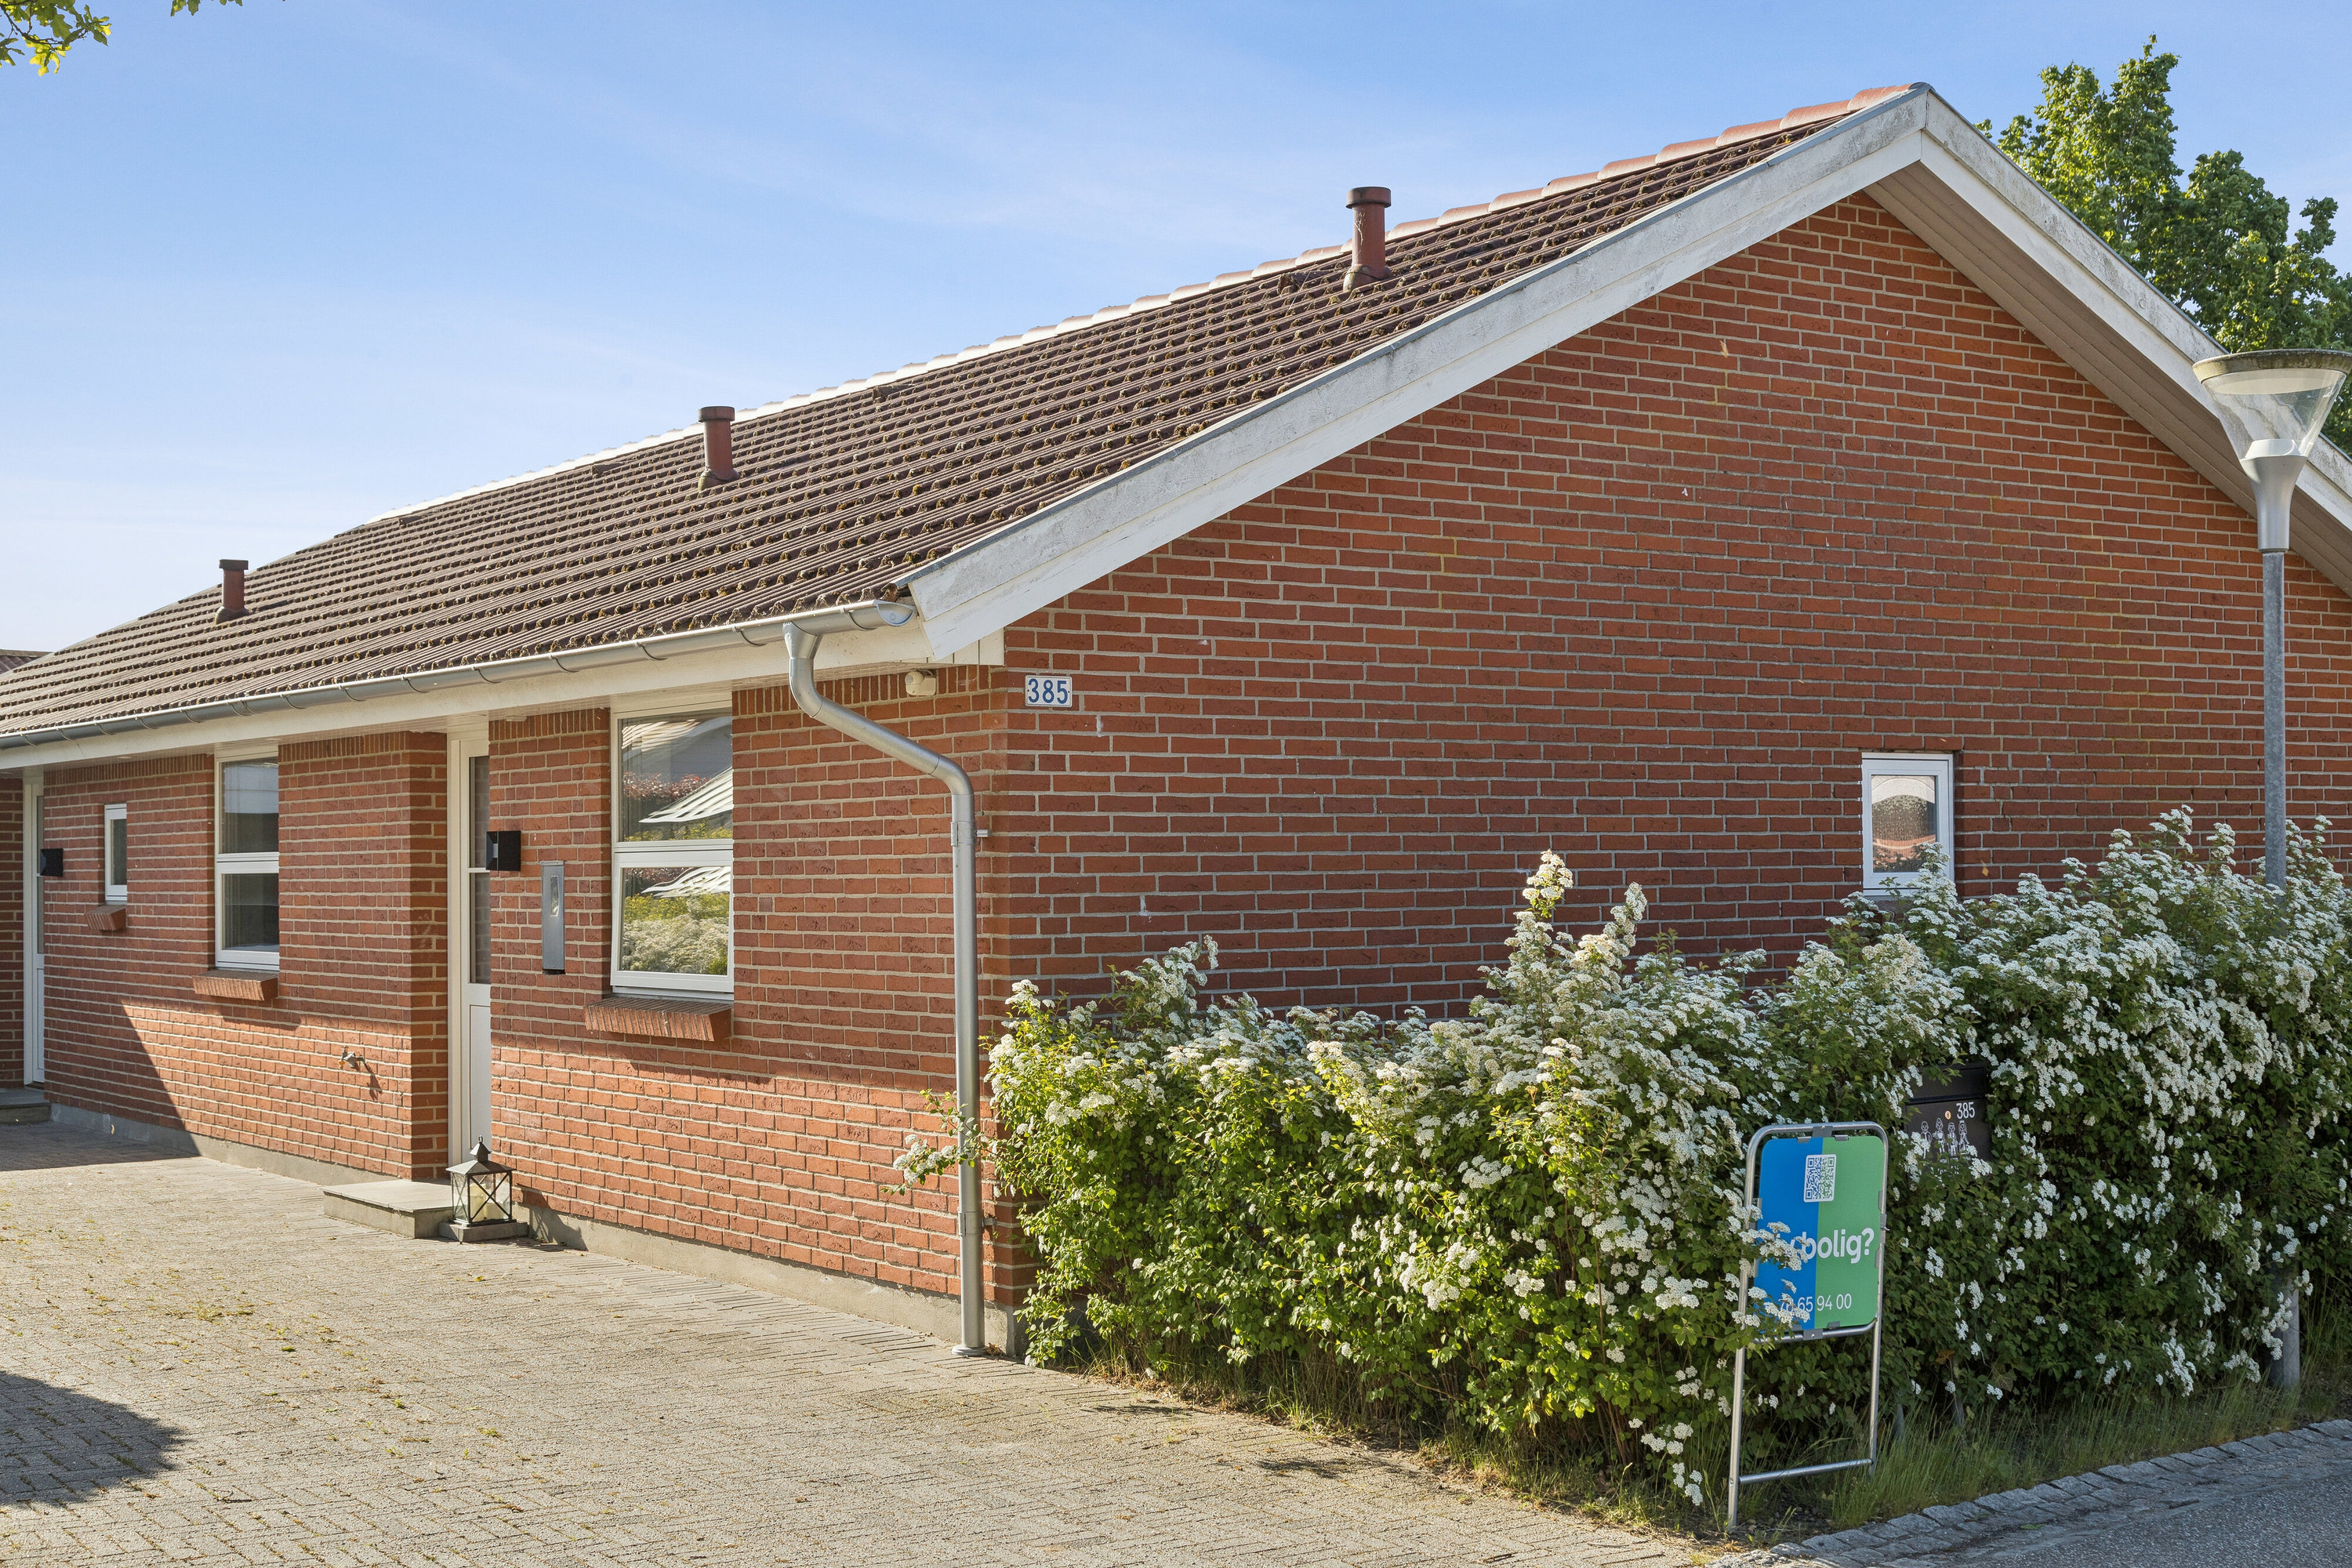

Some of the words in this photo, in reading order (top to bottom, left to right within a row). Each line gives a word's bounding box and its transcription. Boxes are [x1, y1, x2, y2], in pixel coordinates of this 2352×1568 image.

[1028, 678, 1069, 704] 385
[1956, 1102, 1976, 1120] 385
[1801, 1227, 1875, 1264] bolig?
[1797, 1296, 1814, 1312] 65
[1817, 1294, 1833, 1312] 94
[1836, 1293, 1853, 1309] 00
